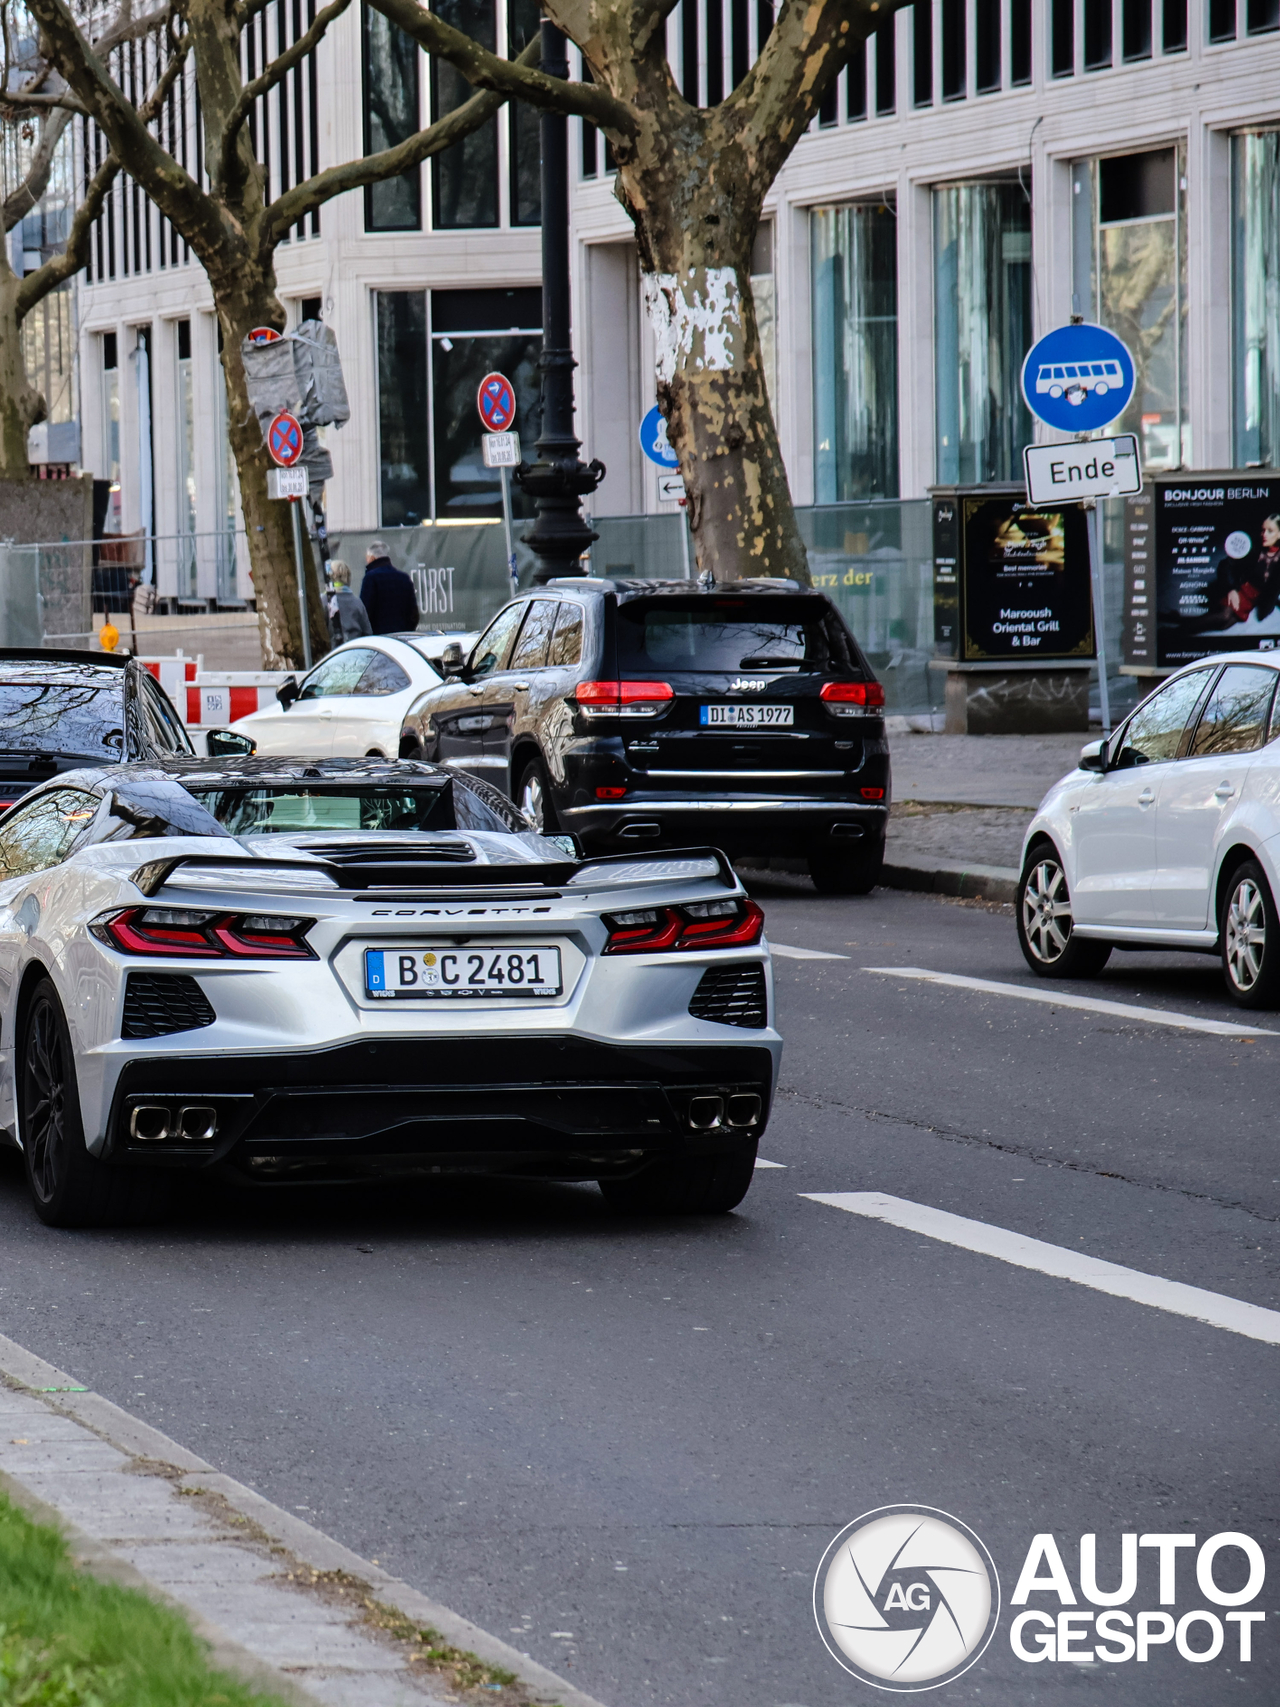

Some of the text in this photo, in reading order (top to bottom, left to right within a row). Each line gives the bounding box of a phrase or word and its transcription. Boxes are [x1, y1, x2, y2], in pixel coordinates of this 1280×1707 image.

[1050, 457, 1115, 484] Ende
[1164, 488, 1225, 502] BONJOUR
[1227, 487, 1269, 500] BERLIN
[843, 568, 873, 585] der
[1000, 607, 1052, 619] Marooush
[993, 620, 1060, 634] Oriental Grill
[1011, 635, 1042, 647] & Bar
[731, 678, 766, 691] Jeep
[710, 707, 727, 722] DI
[737, 707, 755, 722] AS
[757, 707, 791, 722] 1977
[371, 906, 552, 916] CORVETTE
[398, 955, 418, 986] B
[440, 954, 460, 985] C
[467, 954, 545, 985] 2481
